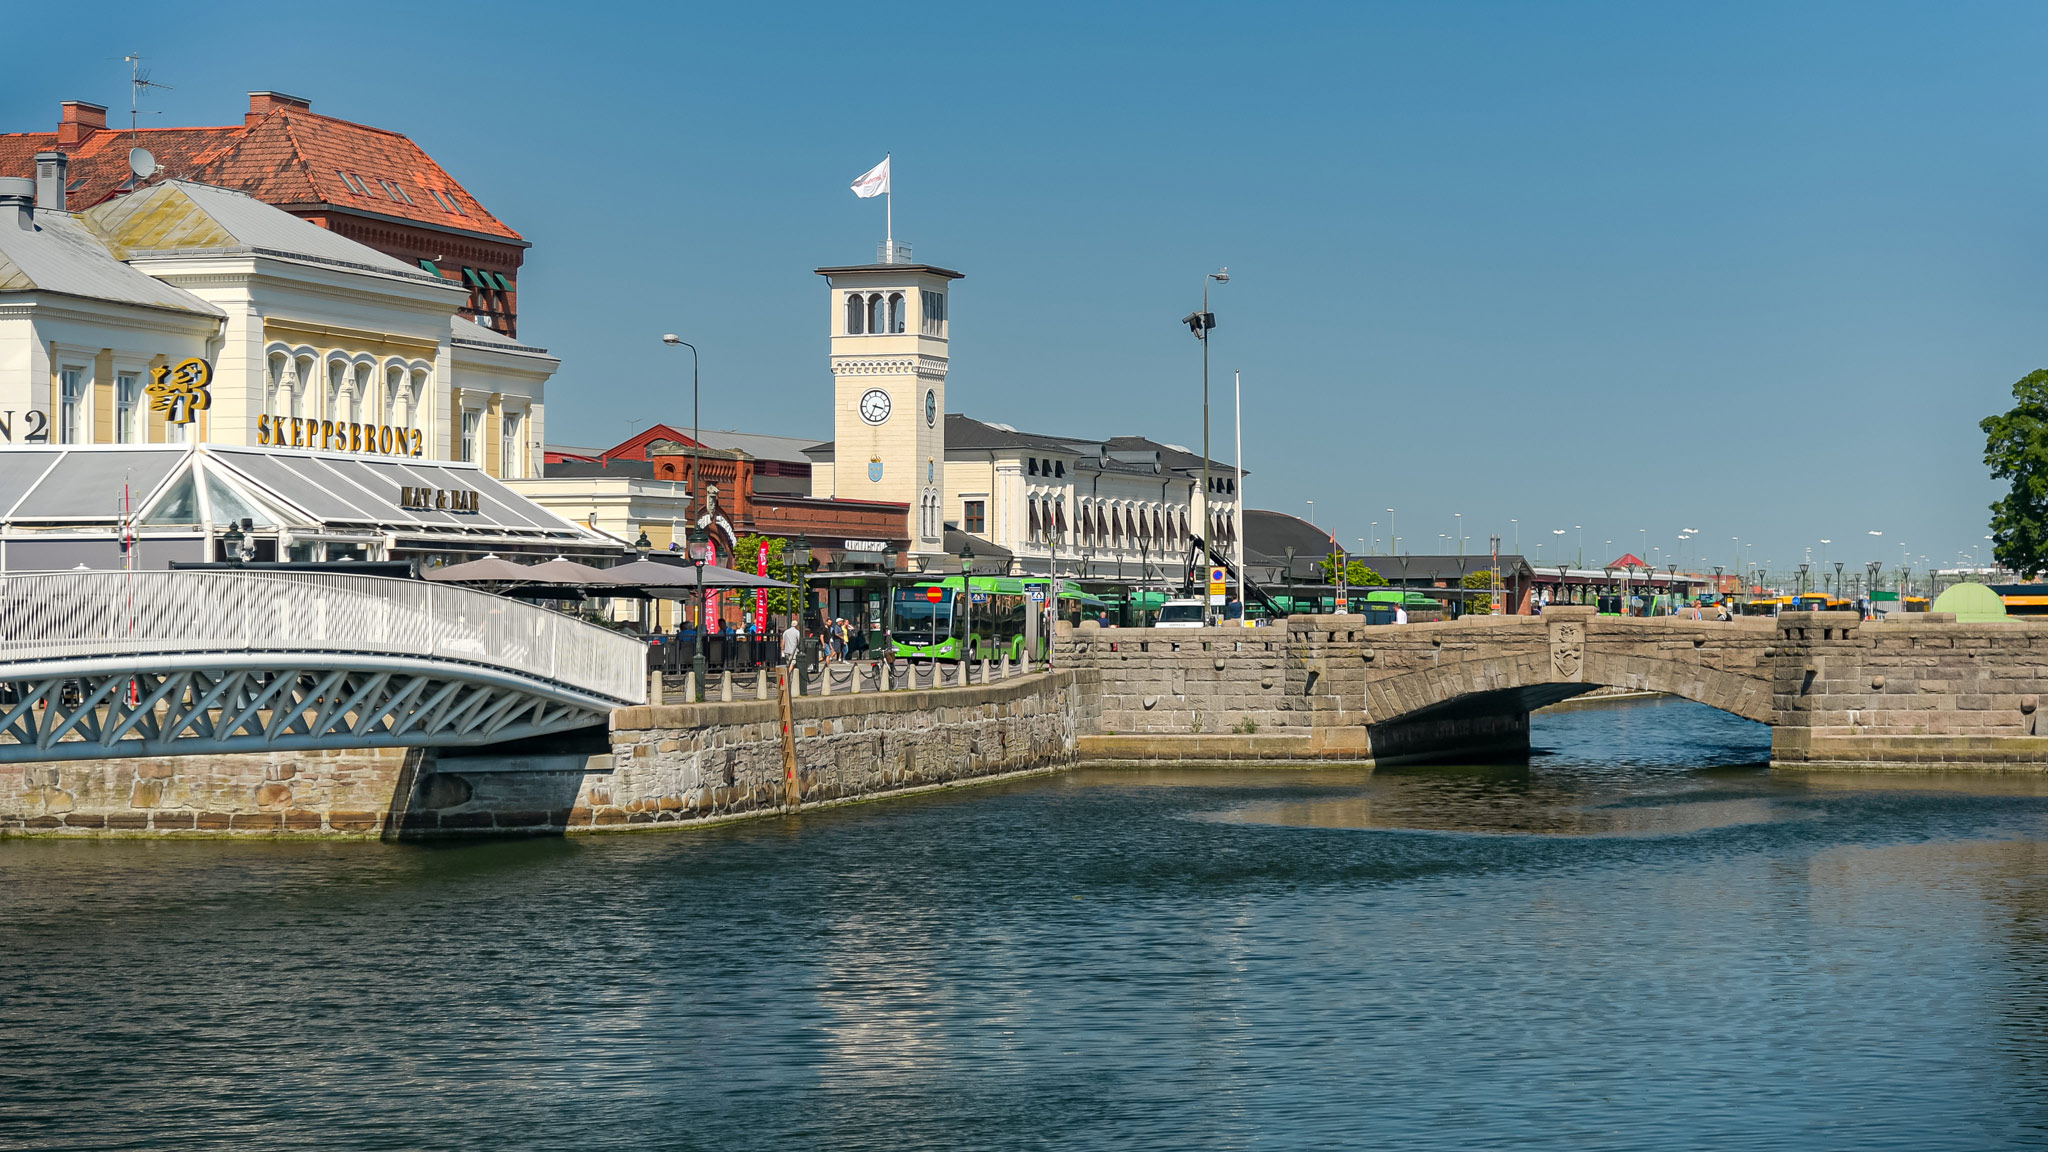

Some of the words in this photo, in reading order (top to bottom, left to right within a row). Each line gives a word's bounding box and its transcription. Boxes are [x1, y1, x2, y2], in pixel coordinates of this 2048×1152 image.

[401, 486, 432, 508] MAT
[436, 489, 447, 509] &
[451, 490, 480, 511] BAR
